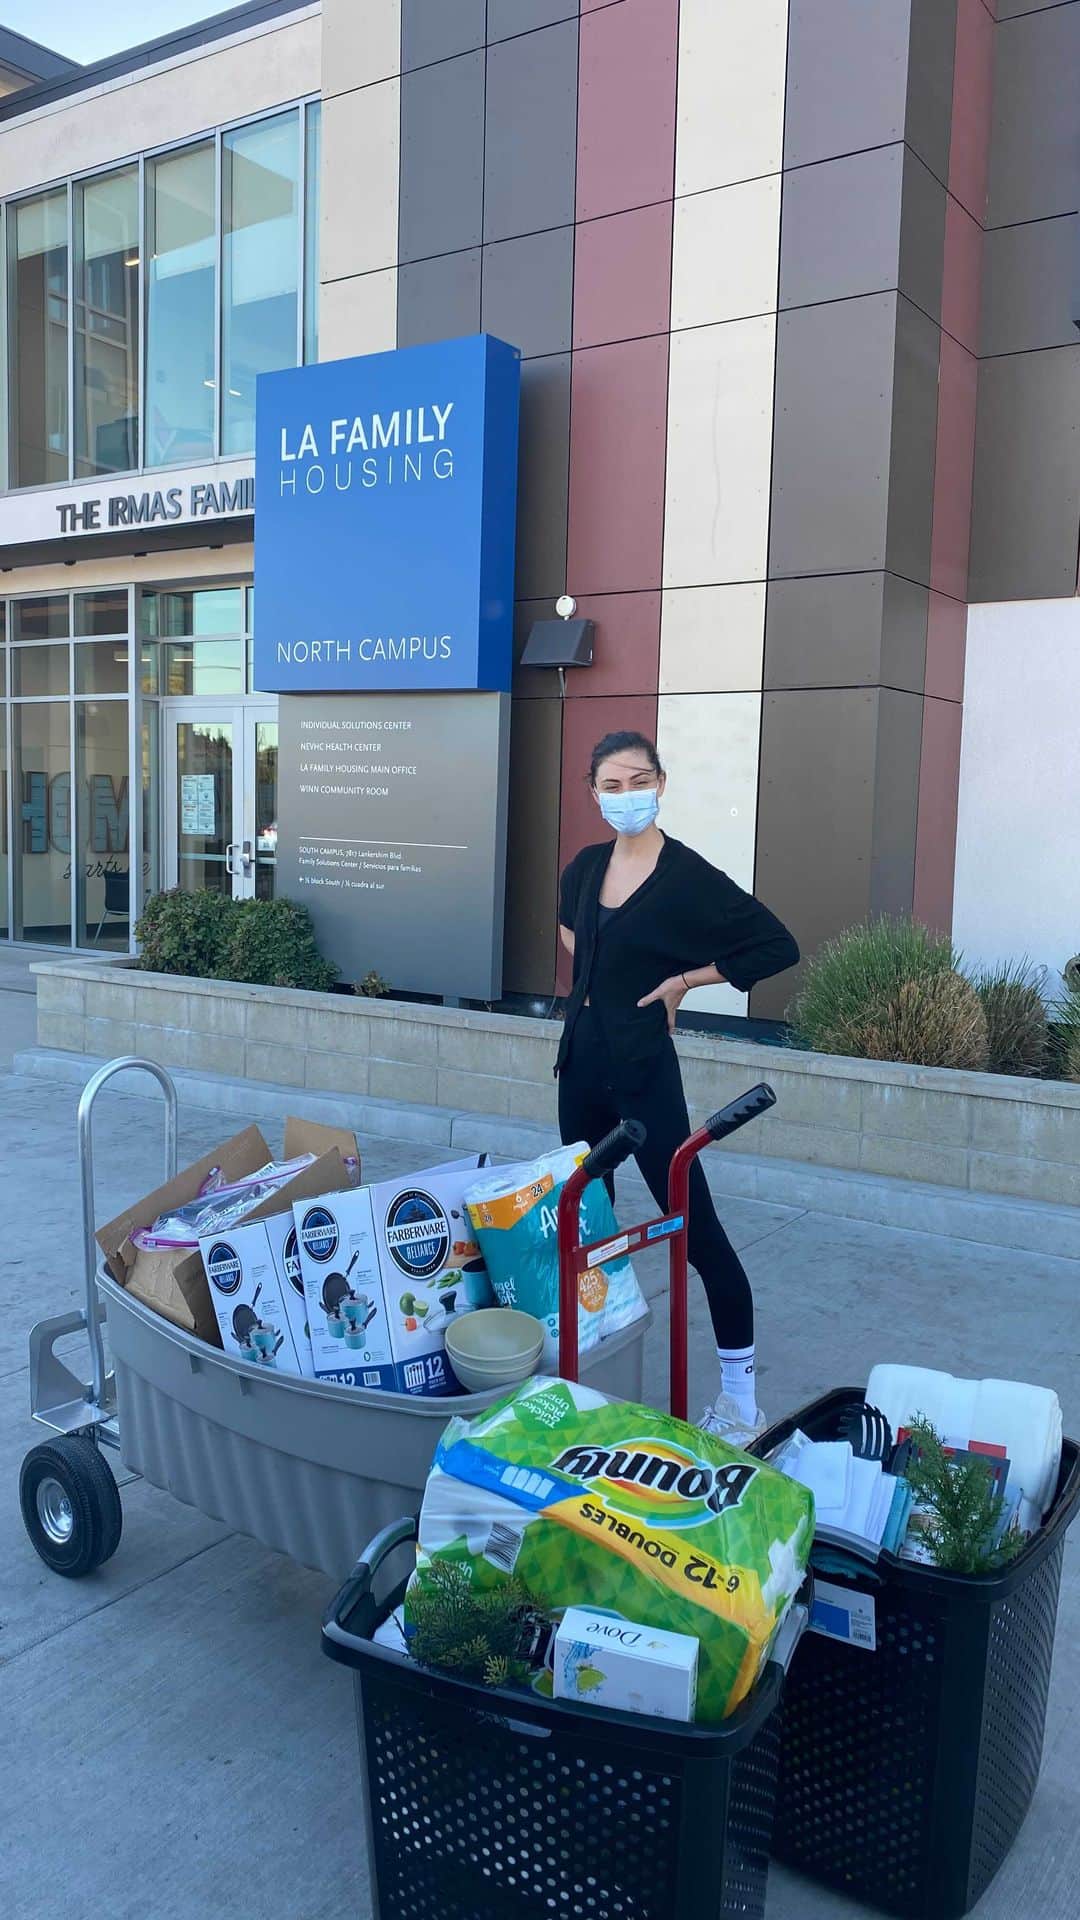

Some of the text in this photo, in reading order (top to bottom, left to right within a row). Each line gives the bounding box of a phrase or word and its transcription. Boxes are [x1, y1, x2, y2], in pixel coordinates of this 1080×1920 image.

[281, 402, 454, 461] LA FAMILY
[280, 448, 454, 497] HOUSING
[56, 477, 255, 533] THE IRMAS FAMIL
[277, 635, 452, 663] NORTH CAMPUS
[300, 721, 412, 730] INDIVIDUAL SOLUTIONS CENTER
[300, 742, 382, 752] NEVHC HEALTH CENTER
[300, 763, 417, 775] LA FAMILY HOUSING MAIN OFFICE
[300, 784, 389, 795] WINN COMMUNITY ROOM
[299, 846, 319, 854] SOUTH
[299, 858, 315, 867] Family
[316, 859, 339, 868] Solutions
[341, 860, 358, 868] Center
[387, 865, 399, 873] para
[325, 878, 340, 888] South
[531, 1184, 543, 1197] 24
[302, 1226, 337, 1240] FARBERWARE
[387, 1221, 447, 1243] FARBERWARE
[406, 1241, 436, 1259] RELIANCE
[208, 1260, 240, 1274] FARBERWARE
[426, 1356, 445, 1379] 12
[551, 1446, 758, 1514] Bounty
[579, 1502, 678, 1569] DOUBLES
[683, 1555, 718, 1590] 12
[726, 1575, 740, 1593] 6
[586, 1622, 642, 1648] Dove
